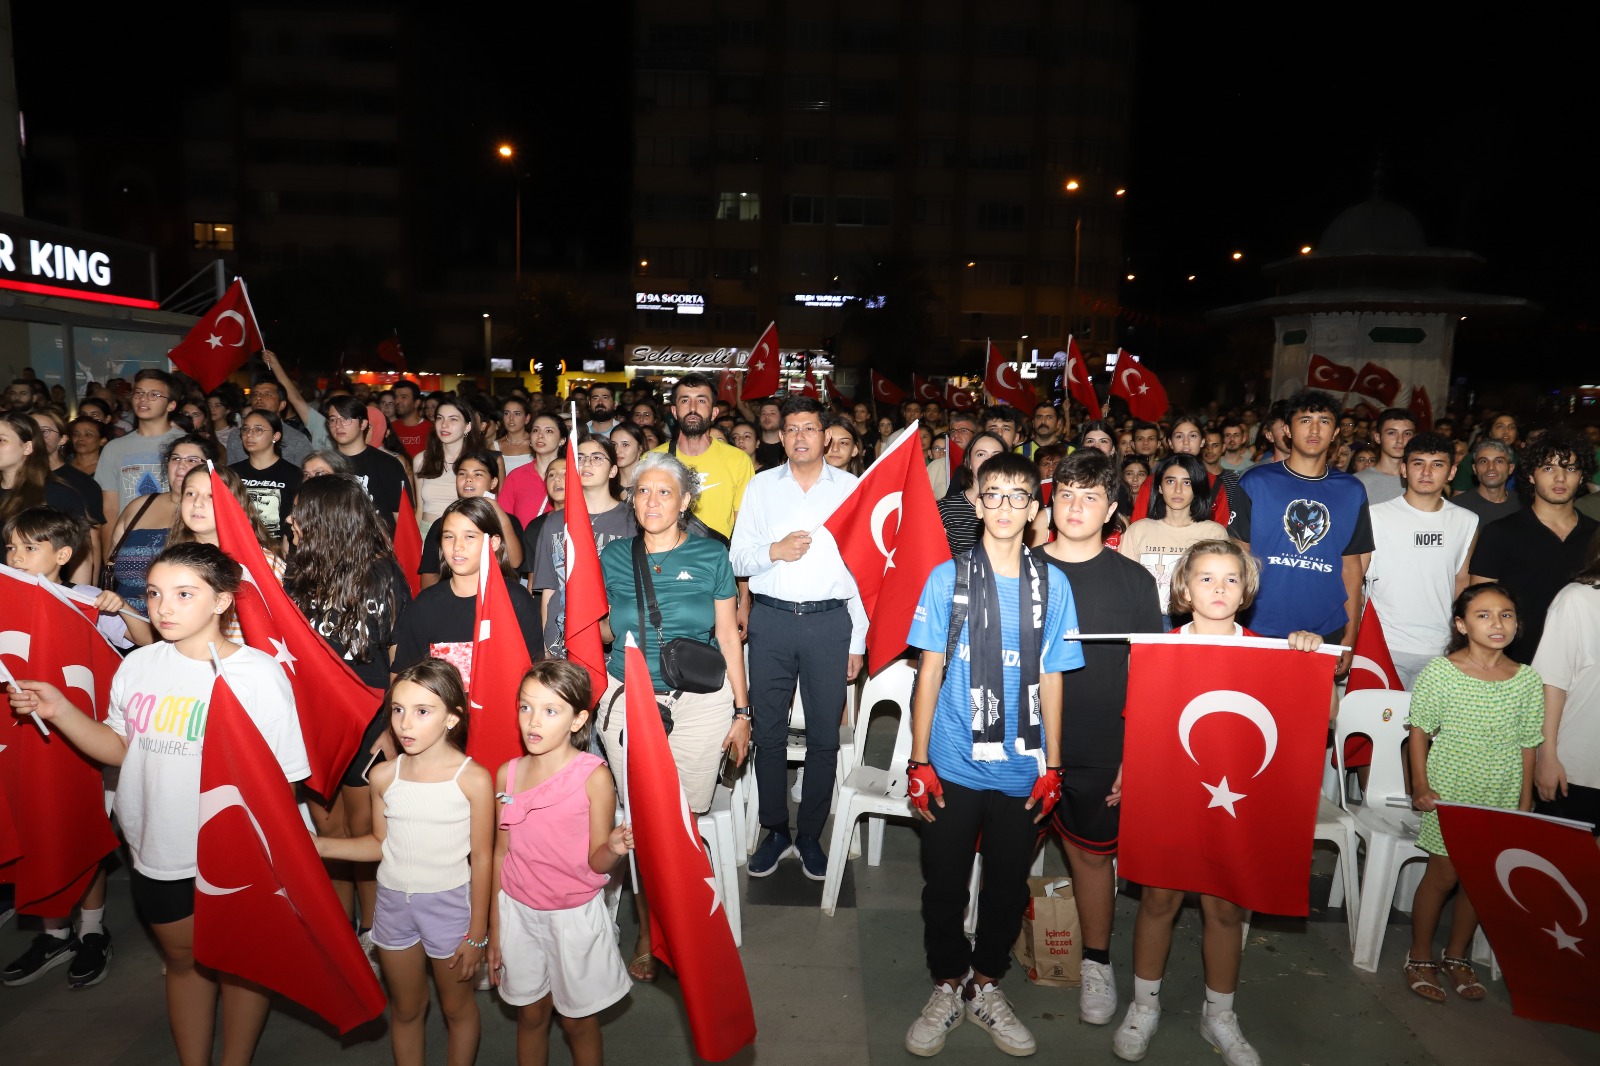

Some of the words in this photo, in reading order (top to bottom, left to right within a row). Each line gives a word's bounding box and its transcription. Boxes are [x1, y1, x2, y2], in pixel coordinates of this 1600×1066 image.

[30, 239, 111, 286] KING
[1415, 533, 1443, 546] NOPE
[1267, 556, 1334, 573] RAVENS
[125, 692, 157, 747] GO
[1045, 928, 1071, 940] İçinde
[1045, 939, 1073, 947] Lezzet
[1049, 947, 1069, 955] Dolu
